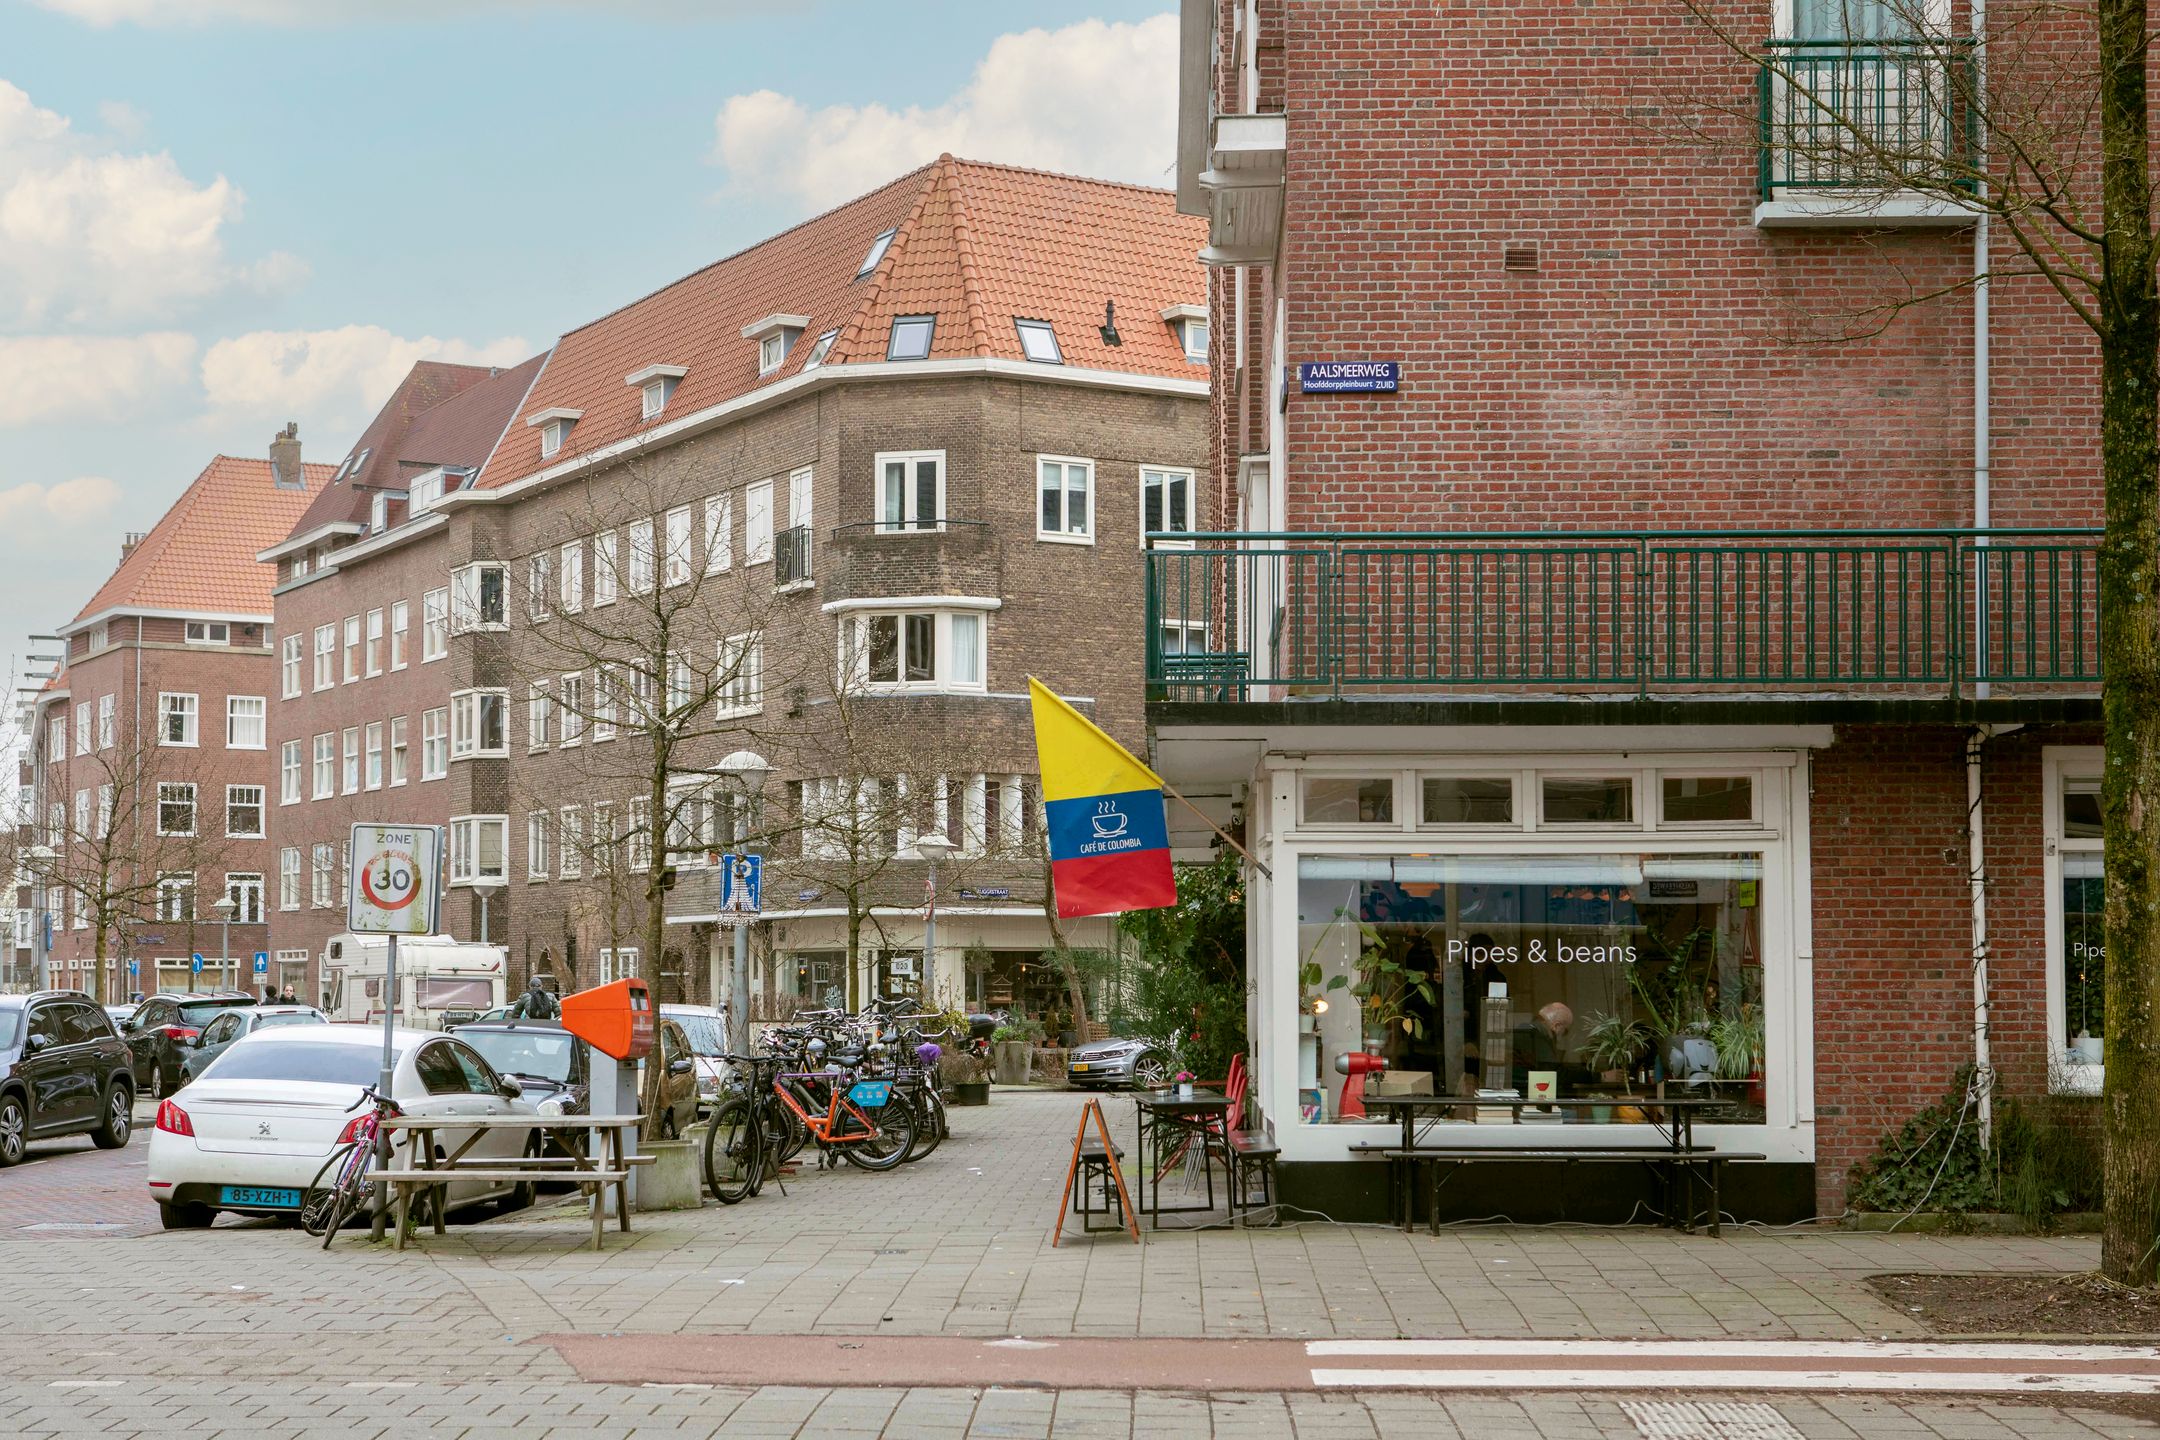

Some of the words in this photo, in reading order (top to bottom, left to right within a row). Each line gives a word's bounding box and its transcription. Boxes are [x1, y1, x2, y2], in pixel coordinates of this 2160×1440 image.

[1310, 364, 1390, 378] AALSMEERWEG
[1304, 380, 1373, 390] Hoofddorppleinbuurt
[1375, 381, 1395, 389] ZUID
[376, 833, 412, 845] ZONE
[1080, 841, 1098, 854] CAFÉ
[1097, 842, 1107, 852] DE
[1107, 837, 1142, 851] COLOMBIA
[374, 869, 410, 891] 30
[1448, 938, 1518, 969] Pipes
[1527, 939, 1548, 963] &
[1557, 938, 1637, 963] beans
[232, 1189, 293, 1204] 85-XZH-1
